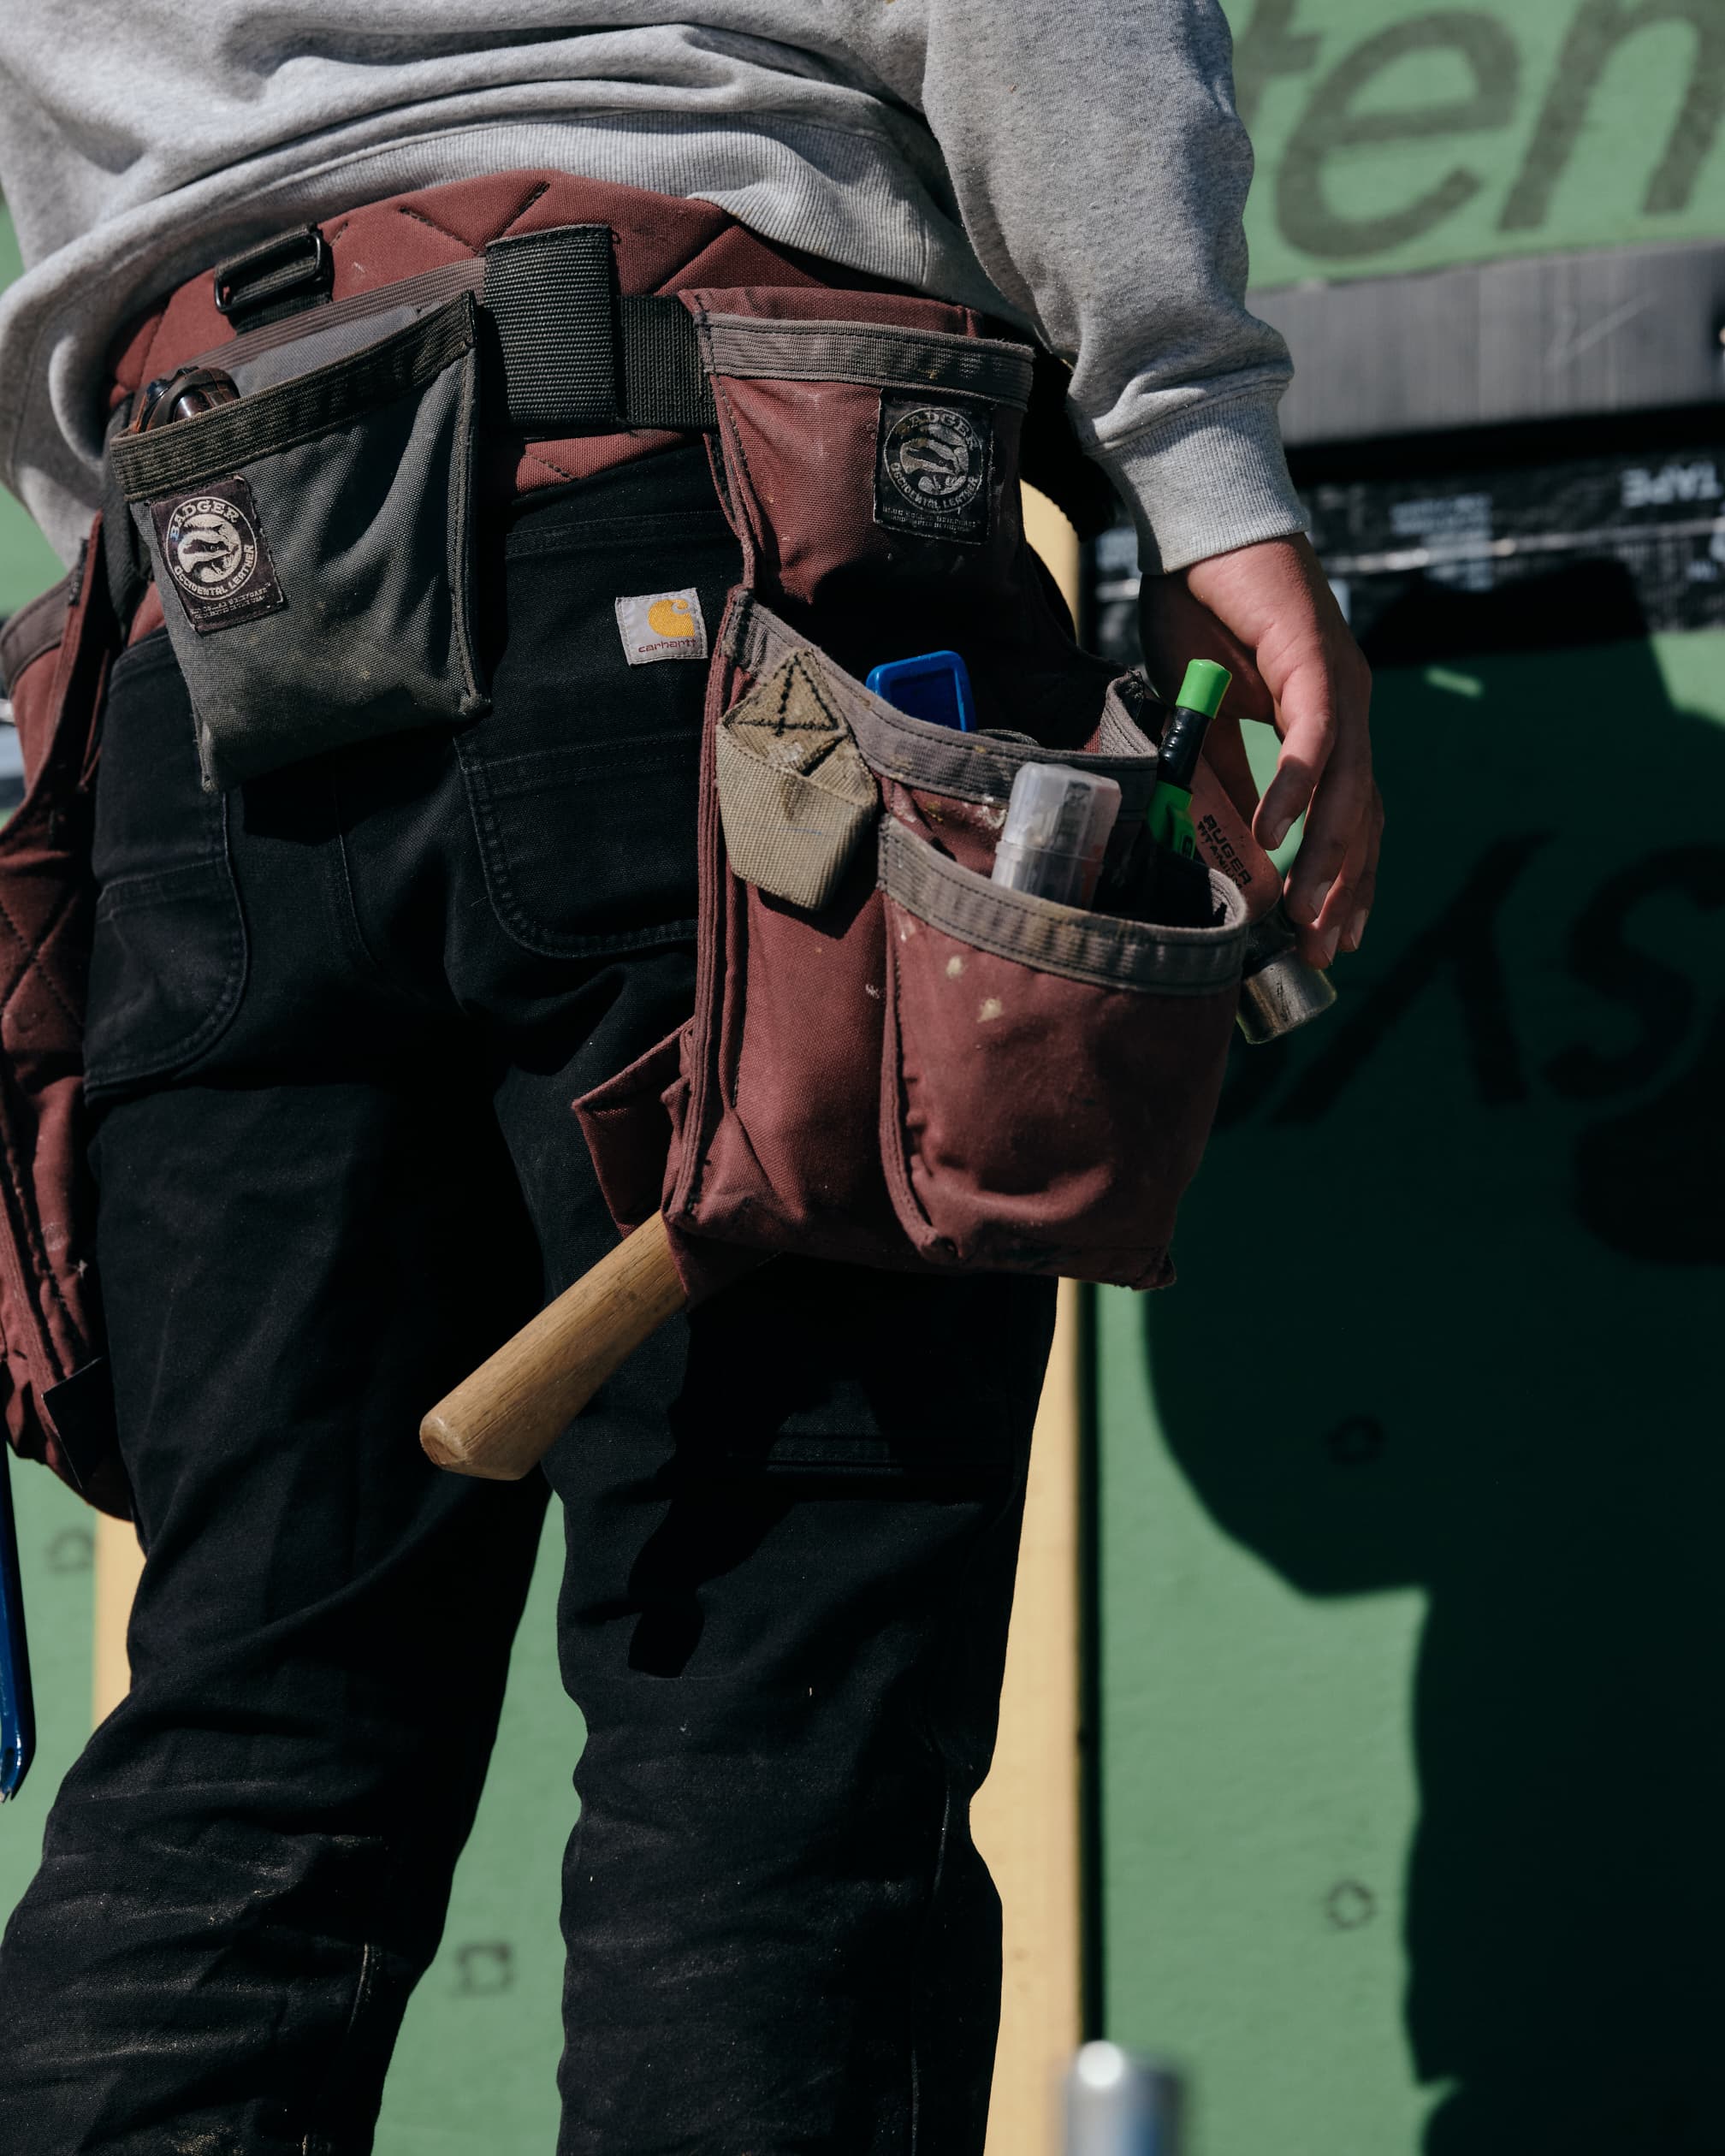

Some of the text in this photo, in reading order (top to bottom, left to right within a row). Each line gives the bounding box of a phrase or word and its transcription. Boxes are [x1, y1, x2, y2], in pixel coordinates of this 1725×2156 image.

[895, 412, 979, 451] ADGER
[890, 463, 979, 509] OCCIDENTAL LEATHER
[170, 500, 240, 541] BADGER
[174, 544, 254, 597] OCCIDENTAL LEATHER
[638, 639, 696, 653] carhartt
